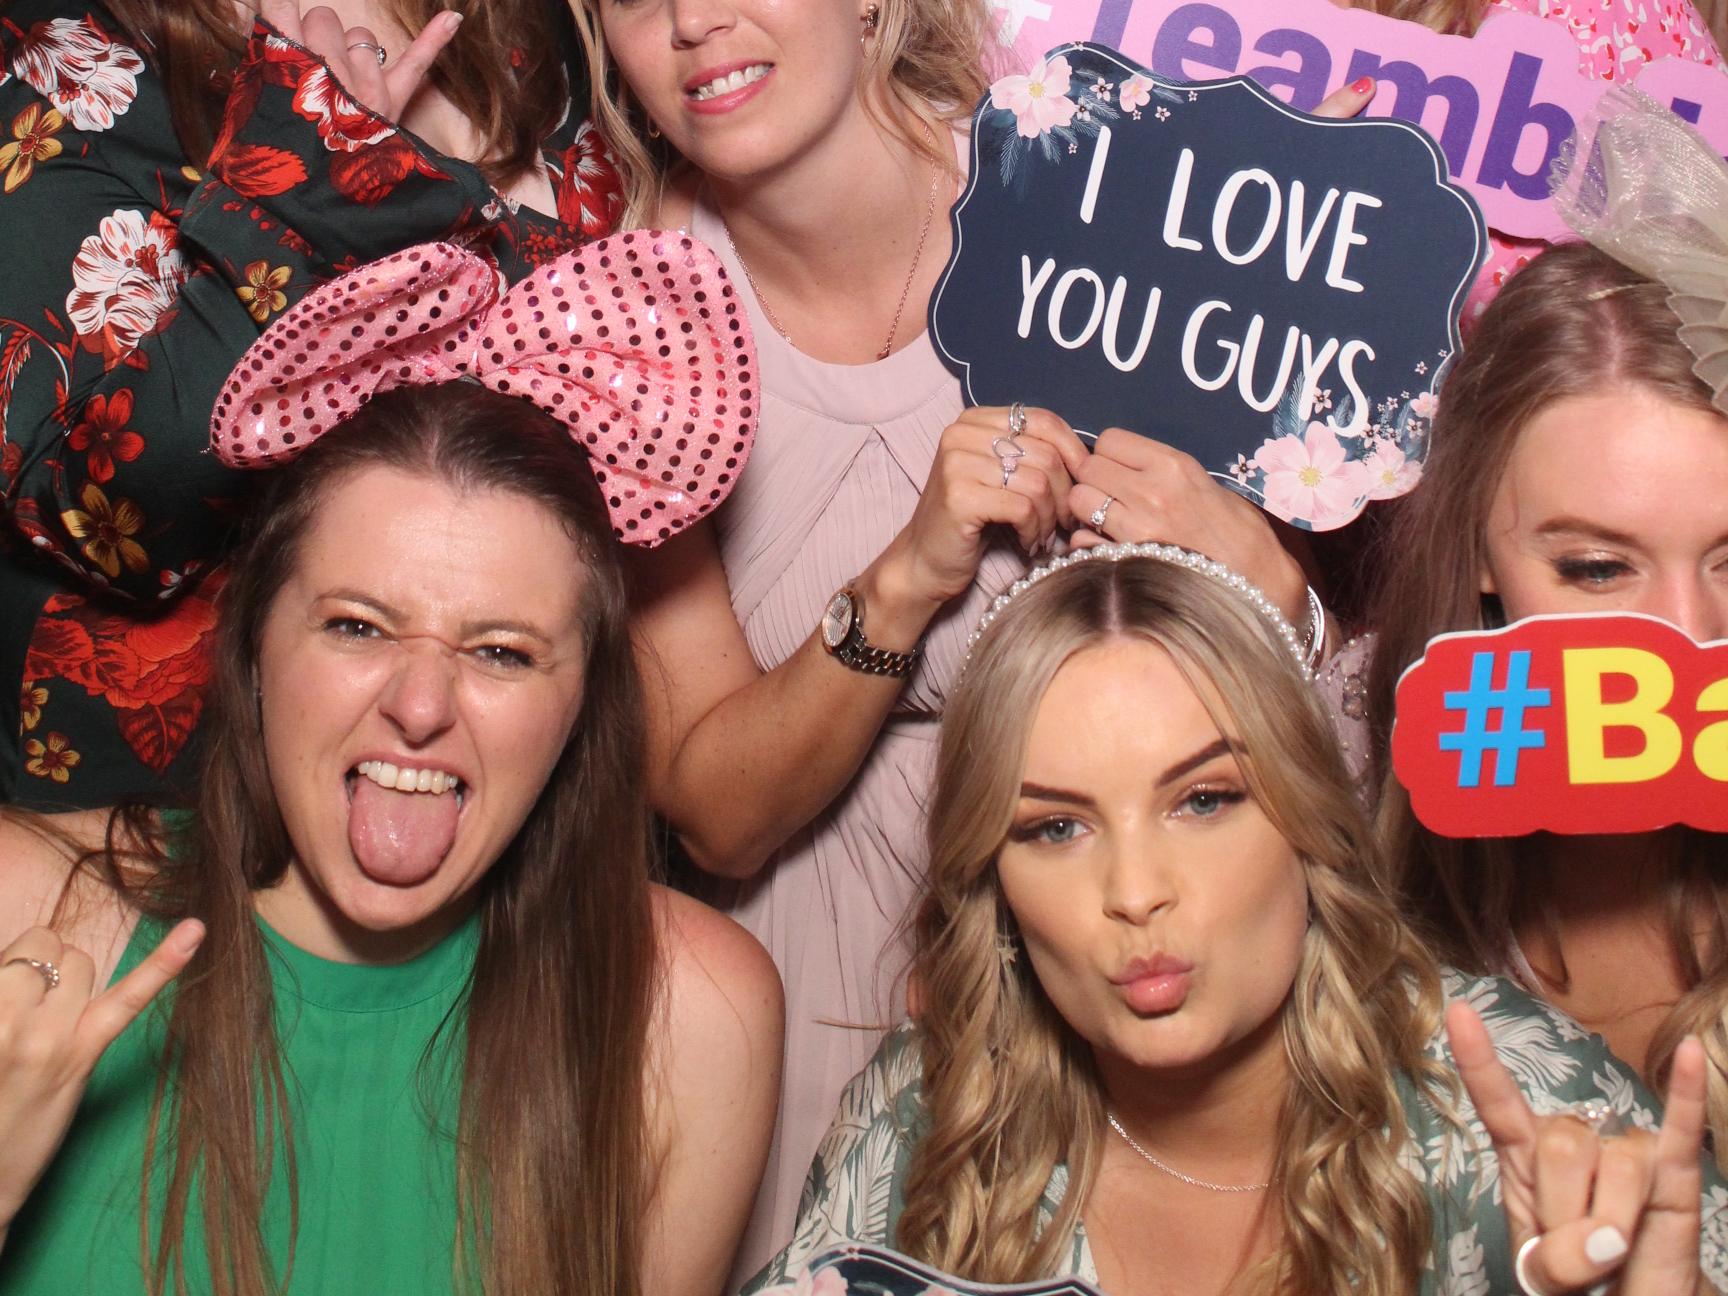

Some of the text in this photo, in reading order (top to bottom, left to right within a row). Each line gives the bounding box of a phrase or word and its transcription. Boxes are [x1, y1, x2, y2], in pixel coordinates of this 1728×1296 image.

[1080, 125, 1383, 292] I LOVE
[1017, 254, 1376, 437] YOU GUYS
